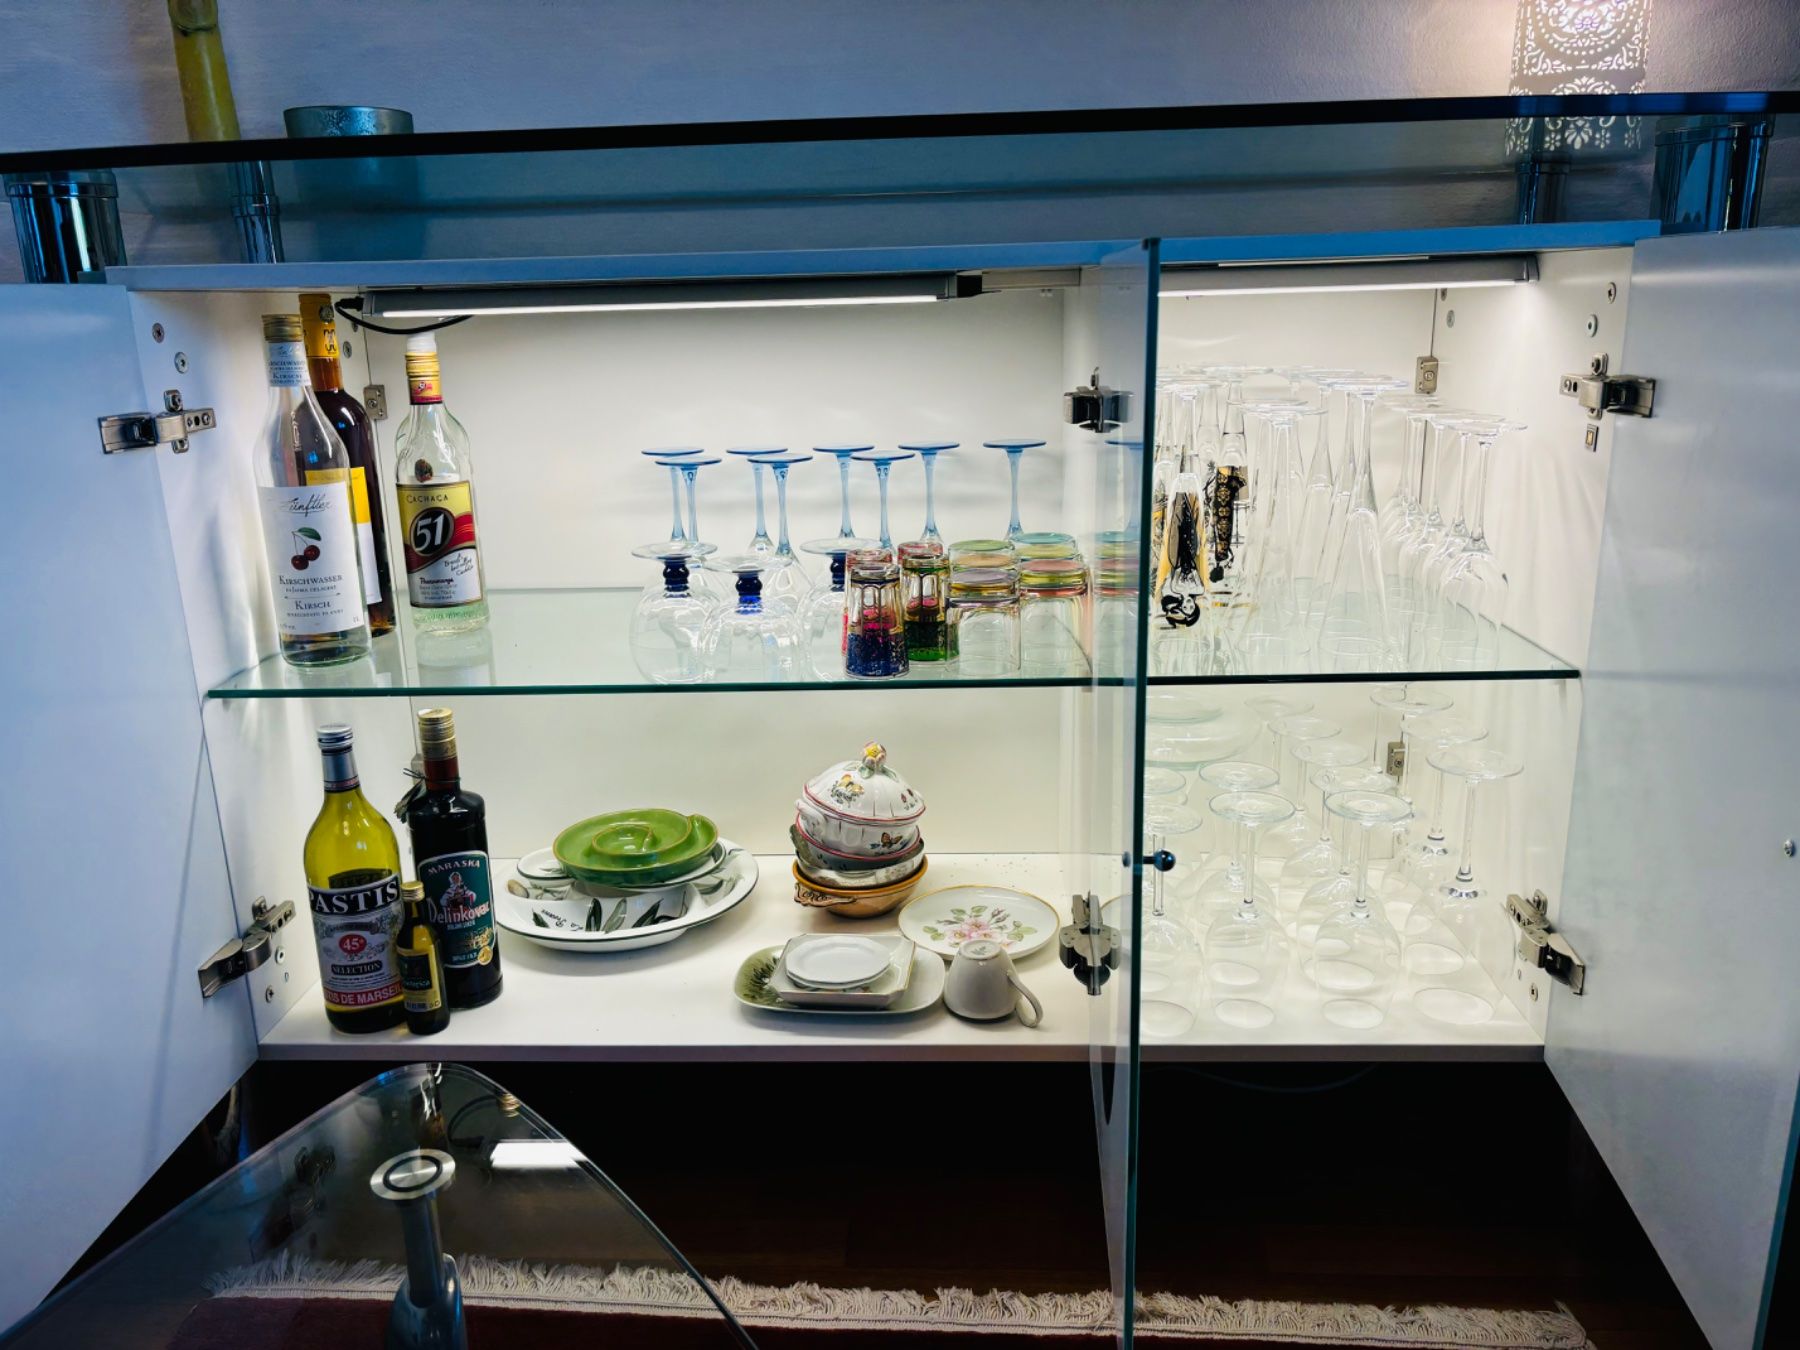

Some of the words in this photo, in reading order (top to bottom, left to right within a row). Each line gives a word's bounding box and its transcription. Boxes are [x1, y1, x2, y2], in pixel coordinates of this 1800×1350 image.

[416, 513, 445, 552] 51
[279, 575, 343, 585] KIRSCHWASSER
[295, 600, 331, 610] KIRSCH
[428, 860, 480, 873] MARASKA
[341, 994, 355, 1004] DE
[356, 983, 402, 1004] MARSEI
